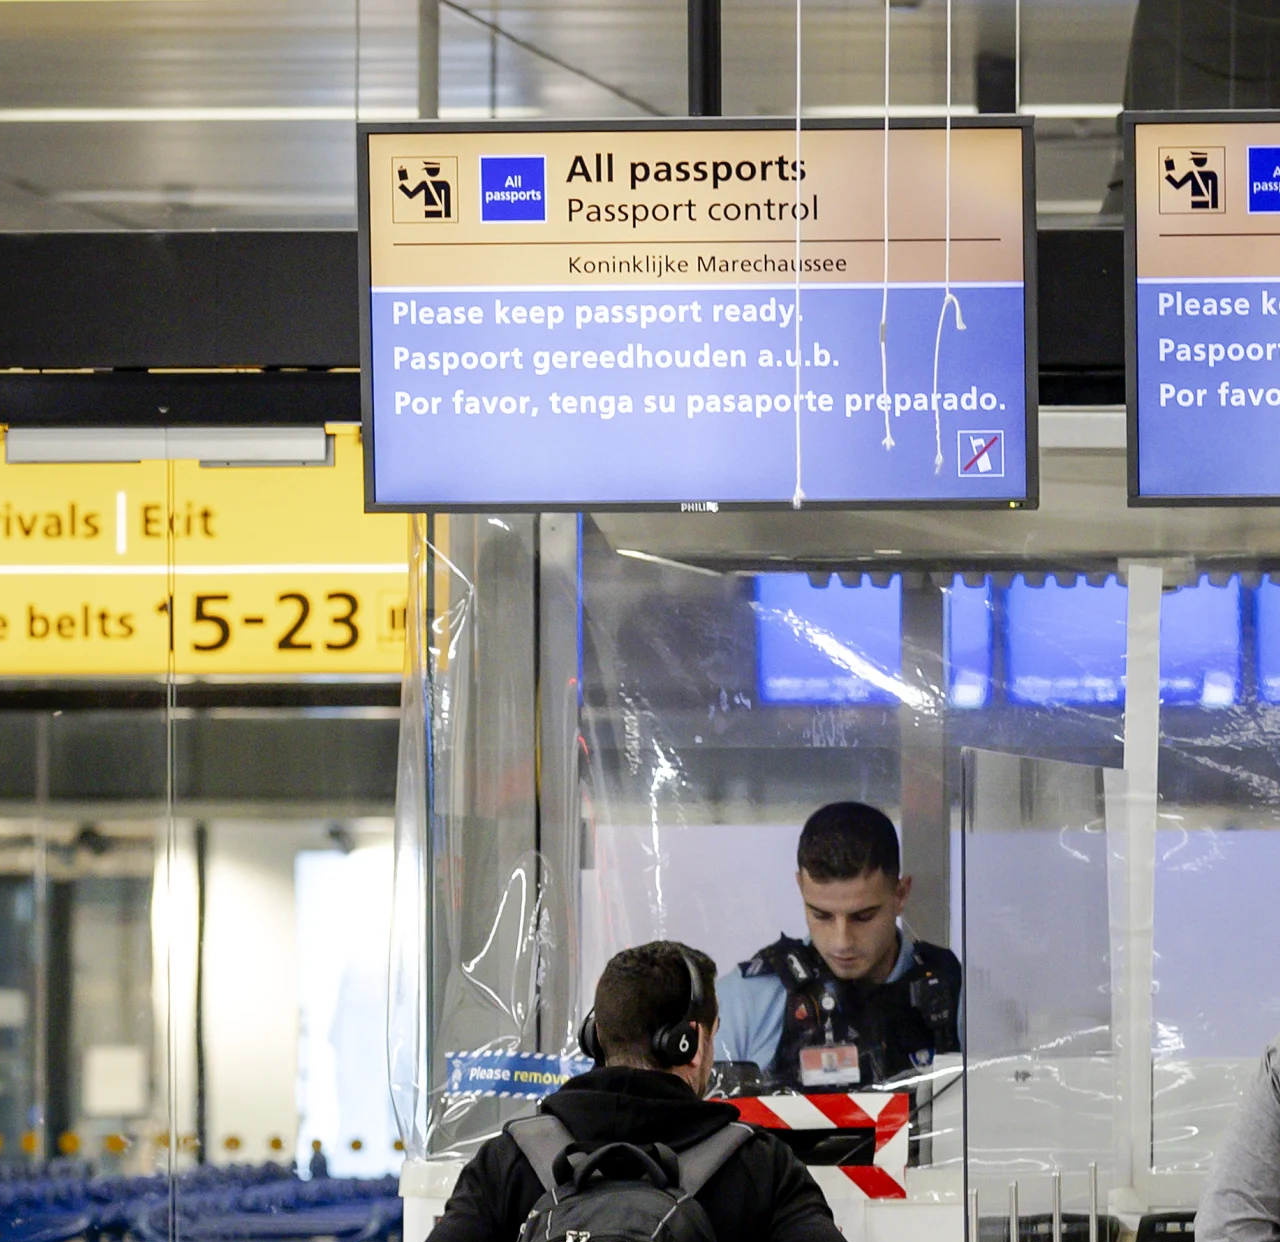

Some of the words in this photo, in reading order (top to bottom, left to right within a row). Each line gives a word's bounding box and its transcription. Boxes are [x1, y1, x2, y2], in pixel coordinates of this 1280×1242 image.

[505, 175, 521, 188] All
[566, 153, 613, 182] All
[631, 156, 805, 189] passports
[486, 189, 541, 203] passports
[569, 199, 696, 228] Passport
[709, 195, 817, 220] control
[569, 255, 688, 277] Koninklijke
[698, 254, 846, 274] Marechaussee
[394, 300, 483, 324] Please
[496, 300, 564, 329] keep
[576, 301, 702, 329] passport
[713, 297, 805, 327] ready.
[1159, 292, 1249, 315] Please
[395, 347, 523, 375] Paspoort
[533, 343, 747, 375] gereedhouden
[758, 344, 839, 368] a.u.b.
[396, 392, 442, 414] Por
[452, 390, 538, 416] favor,
[549, 393, 632, 419] tenga
[644, 395, 675, 413] su
[688, 391, 835, 419] pasaporte
[845, 387, 1006, 417] preparado.
[1160, 384, 1207, 406] Por
[28, 605, 134, 638] belts
[155, 592, 360, 651] 15-23
[470, 1067, 510, 1080] Please
